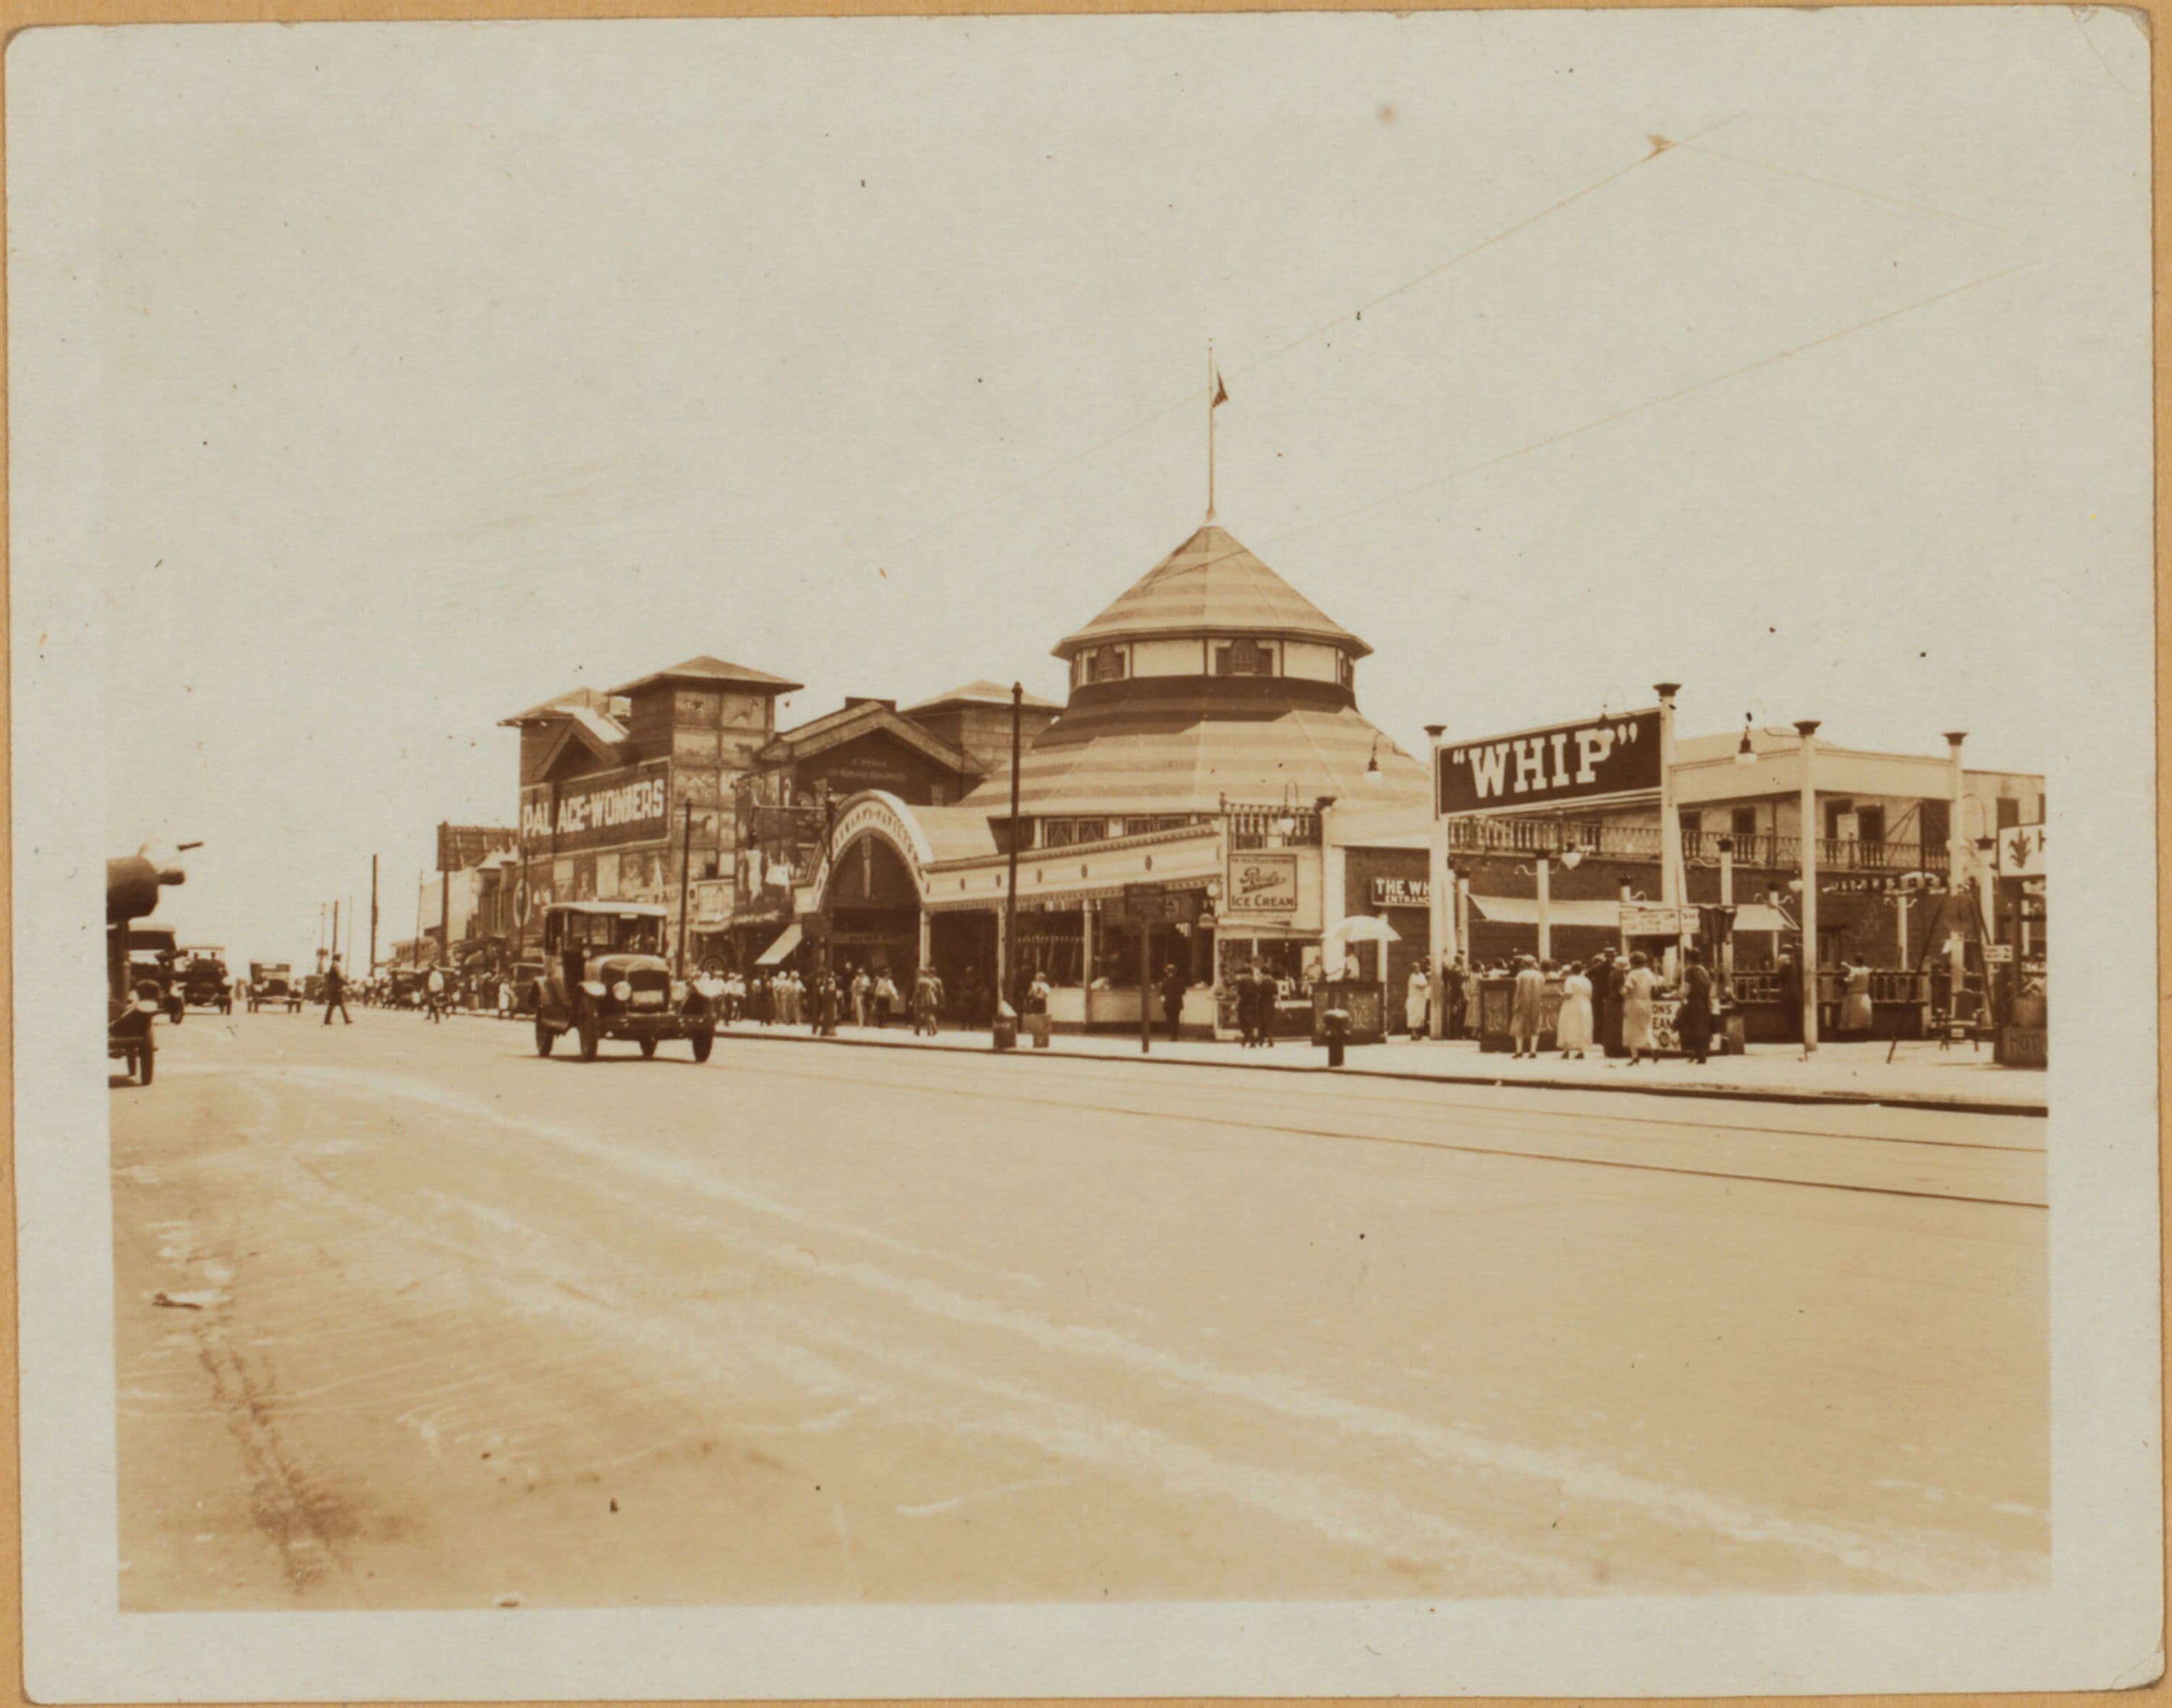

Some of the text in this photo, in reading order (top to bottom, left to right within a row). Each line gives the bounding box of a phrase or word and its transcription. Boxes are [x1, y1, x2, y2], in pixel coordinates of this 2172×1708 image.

[1452, 721, 1638, 798] "WHIP"
[1375, 878, 1430, 896] THE WH
[1231, 894, 1294, 906] ICE CREAM
[1385, 895, 1430, 904] ENTRANC
